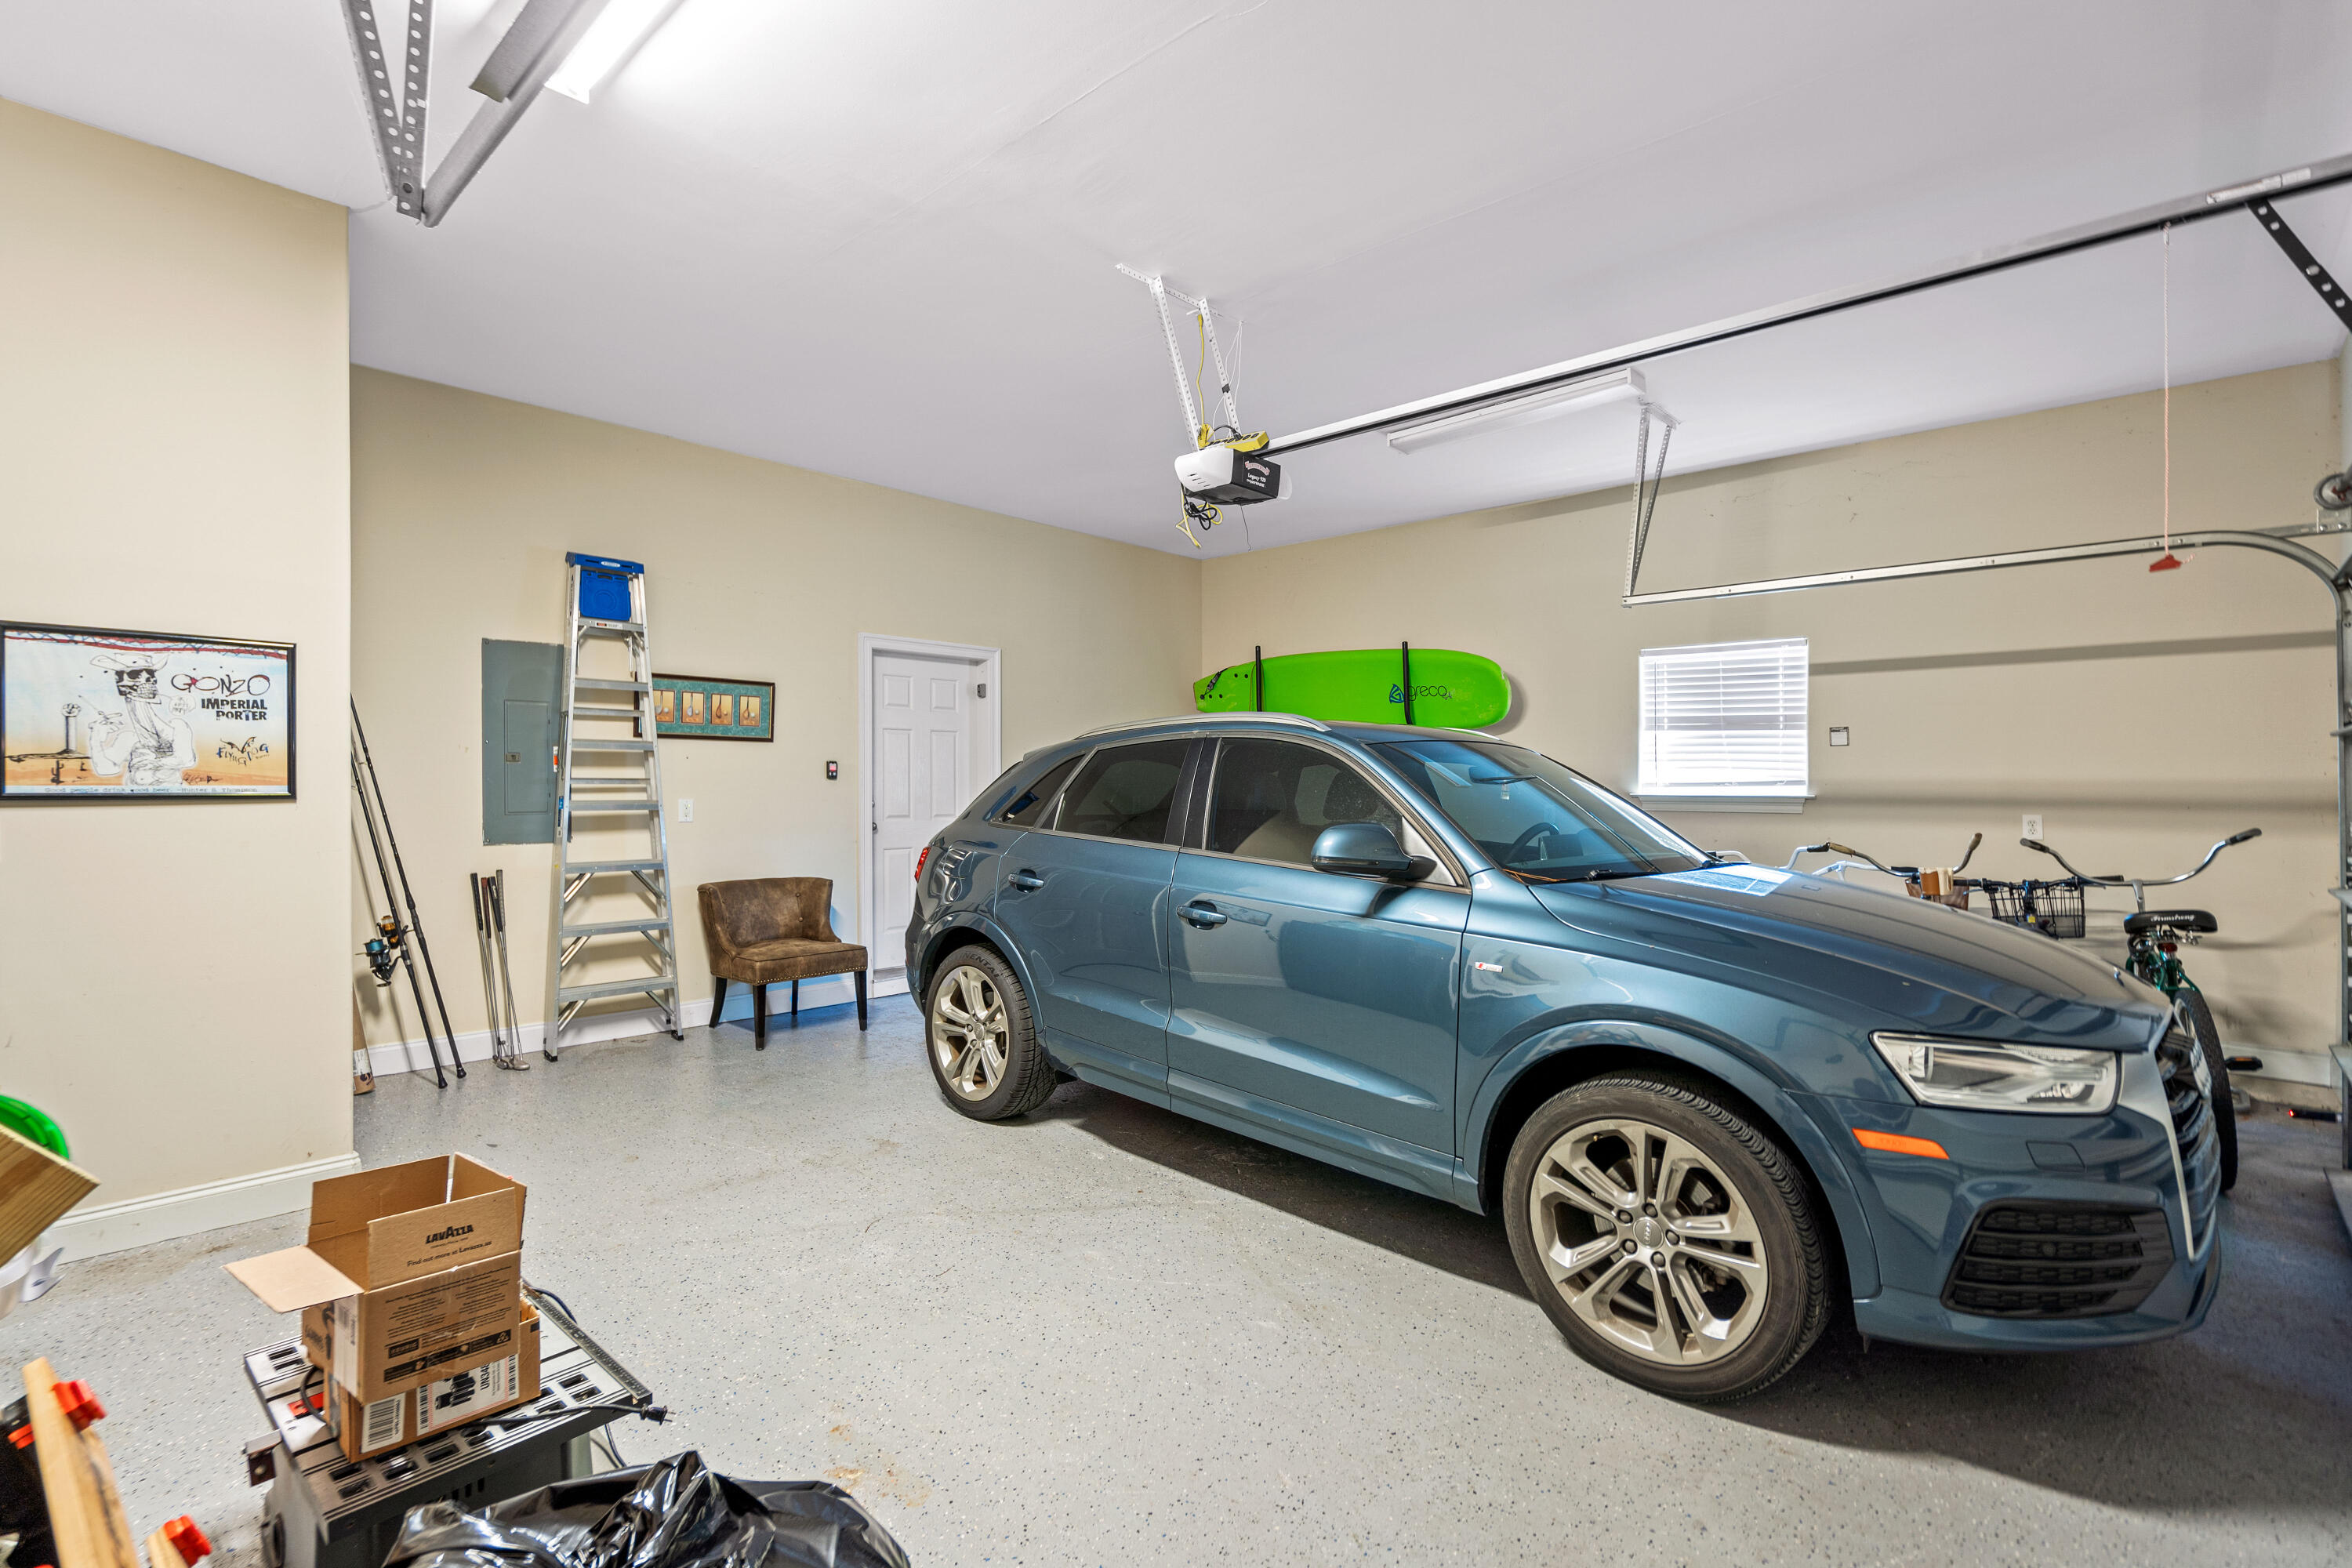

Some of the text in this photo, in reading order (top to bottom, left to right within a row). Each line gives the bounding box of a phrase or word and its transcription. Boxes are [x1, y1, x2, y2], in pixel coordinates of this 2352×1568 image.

[170, 673, 270, 698] GONZO
[201, 698, 268, 710] IMPERIAL
[216, 710, 267, 721] PORTER
[425, 1224, 474, 1245] LAVAZZA
[407, 1258, 423, 1267] Find
[434, 1251, 451, 1260] more
[459, 1240, 493, 1254] Lavazza.us
